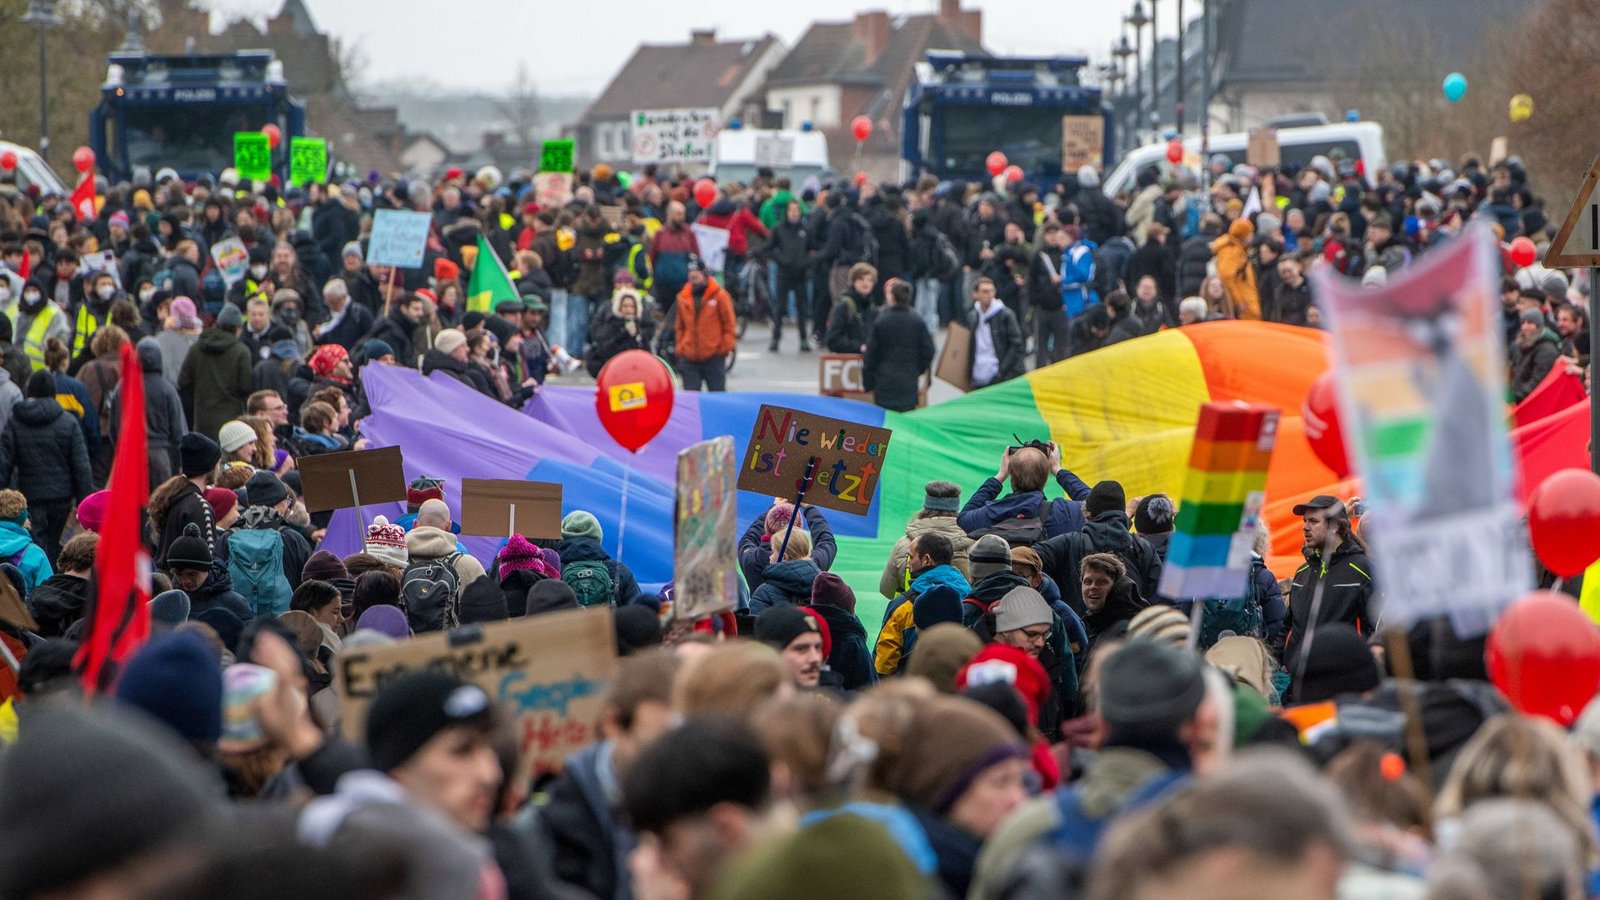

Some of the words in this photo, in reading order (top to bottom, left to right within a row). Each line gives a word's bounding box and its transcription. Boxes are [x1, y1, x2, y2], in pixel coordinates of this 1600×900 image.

[174, 89, 216, 101] POLIZEI
[991, 92, 1032, 105] POLIZEI
[823, 359, 865, 391] FC
[757, 409, 810, 446] Nie
[820, 429, 887, 457] wieder
[750, 444, 788, 477] ist
